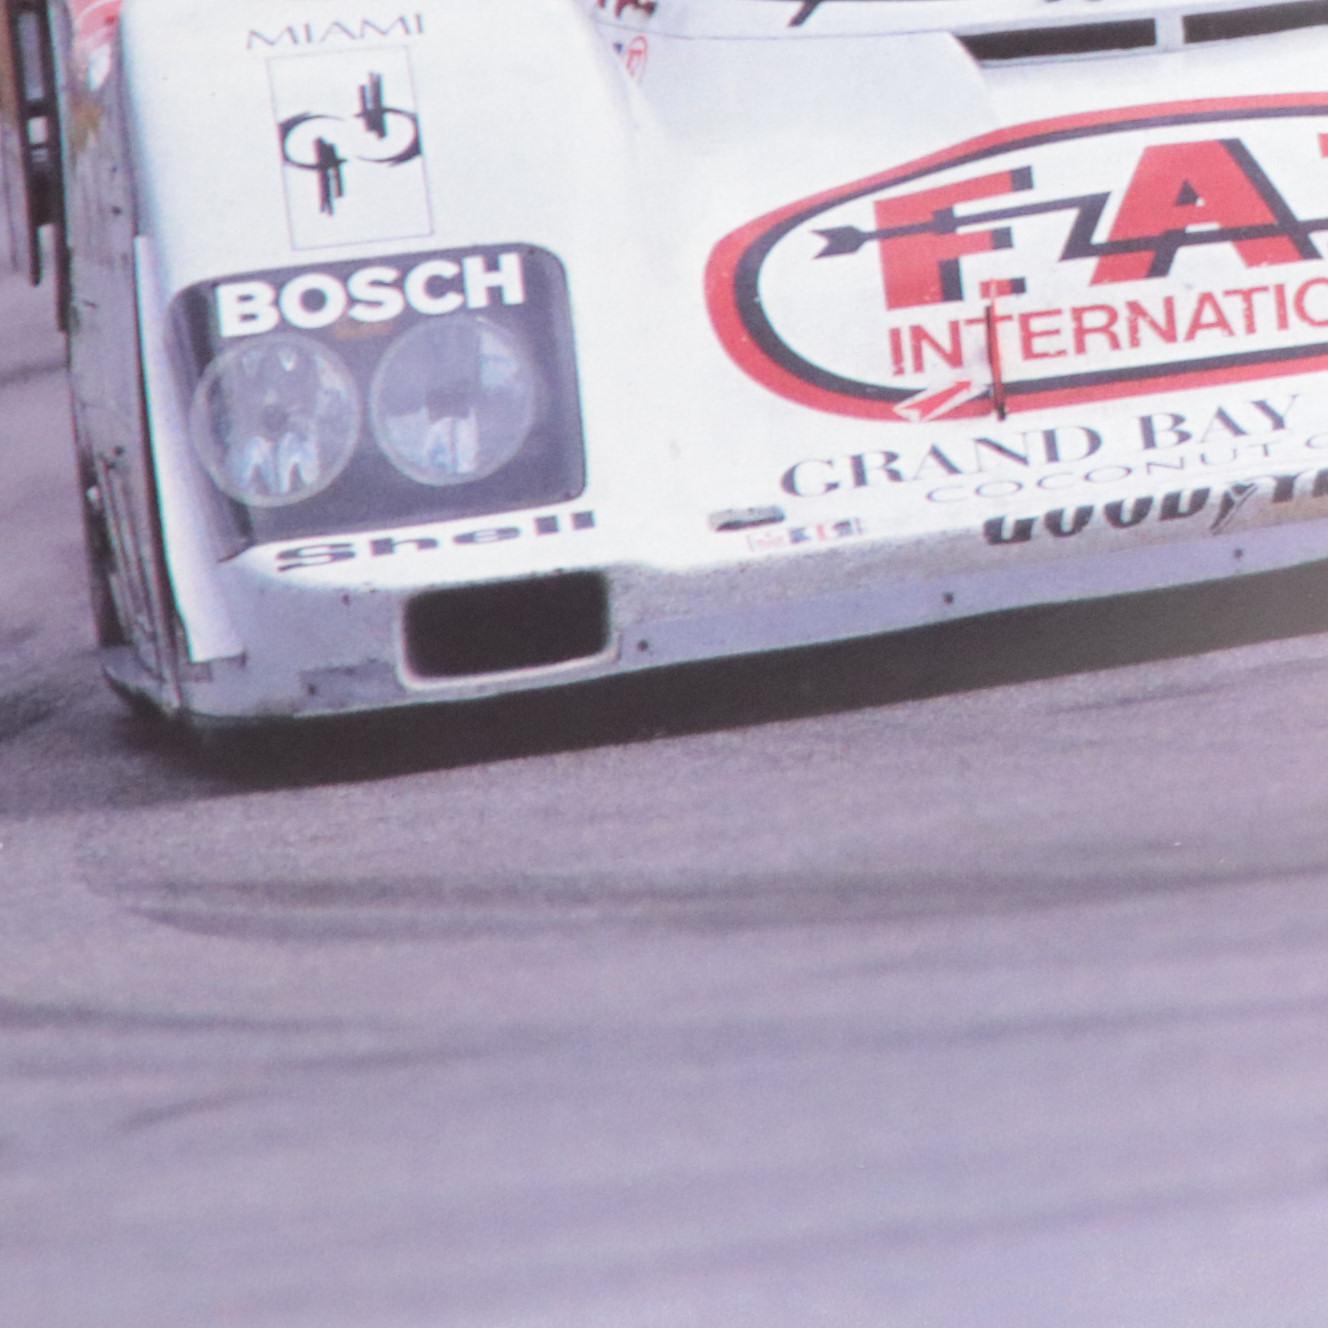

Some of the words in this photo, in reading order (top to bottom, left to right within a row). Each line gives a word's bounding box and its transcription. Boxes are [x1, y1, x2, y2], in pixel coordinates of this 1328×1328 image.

[246, 13, 425, 50] MIAMI
[215, 252, 526, 337] BOSCH
[779, 424, 1103, 499] GRAND
[1138, 389, 1300, 451] BAY
[924, 441, 1274, 504] COCONUT
[274, 509, 597, 572] Shell
